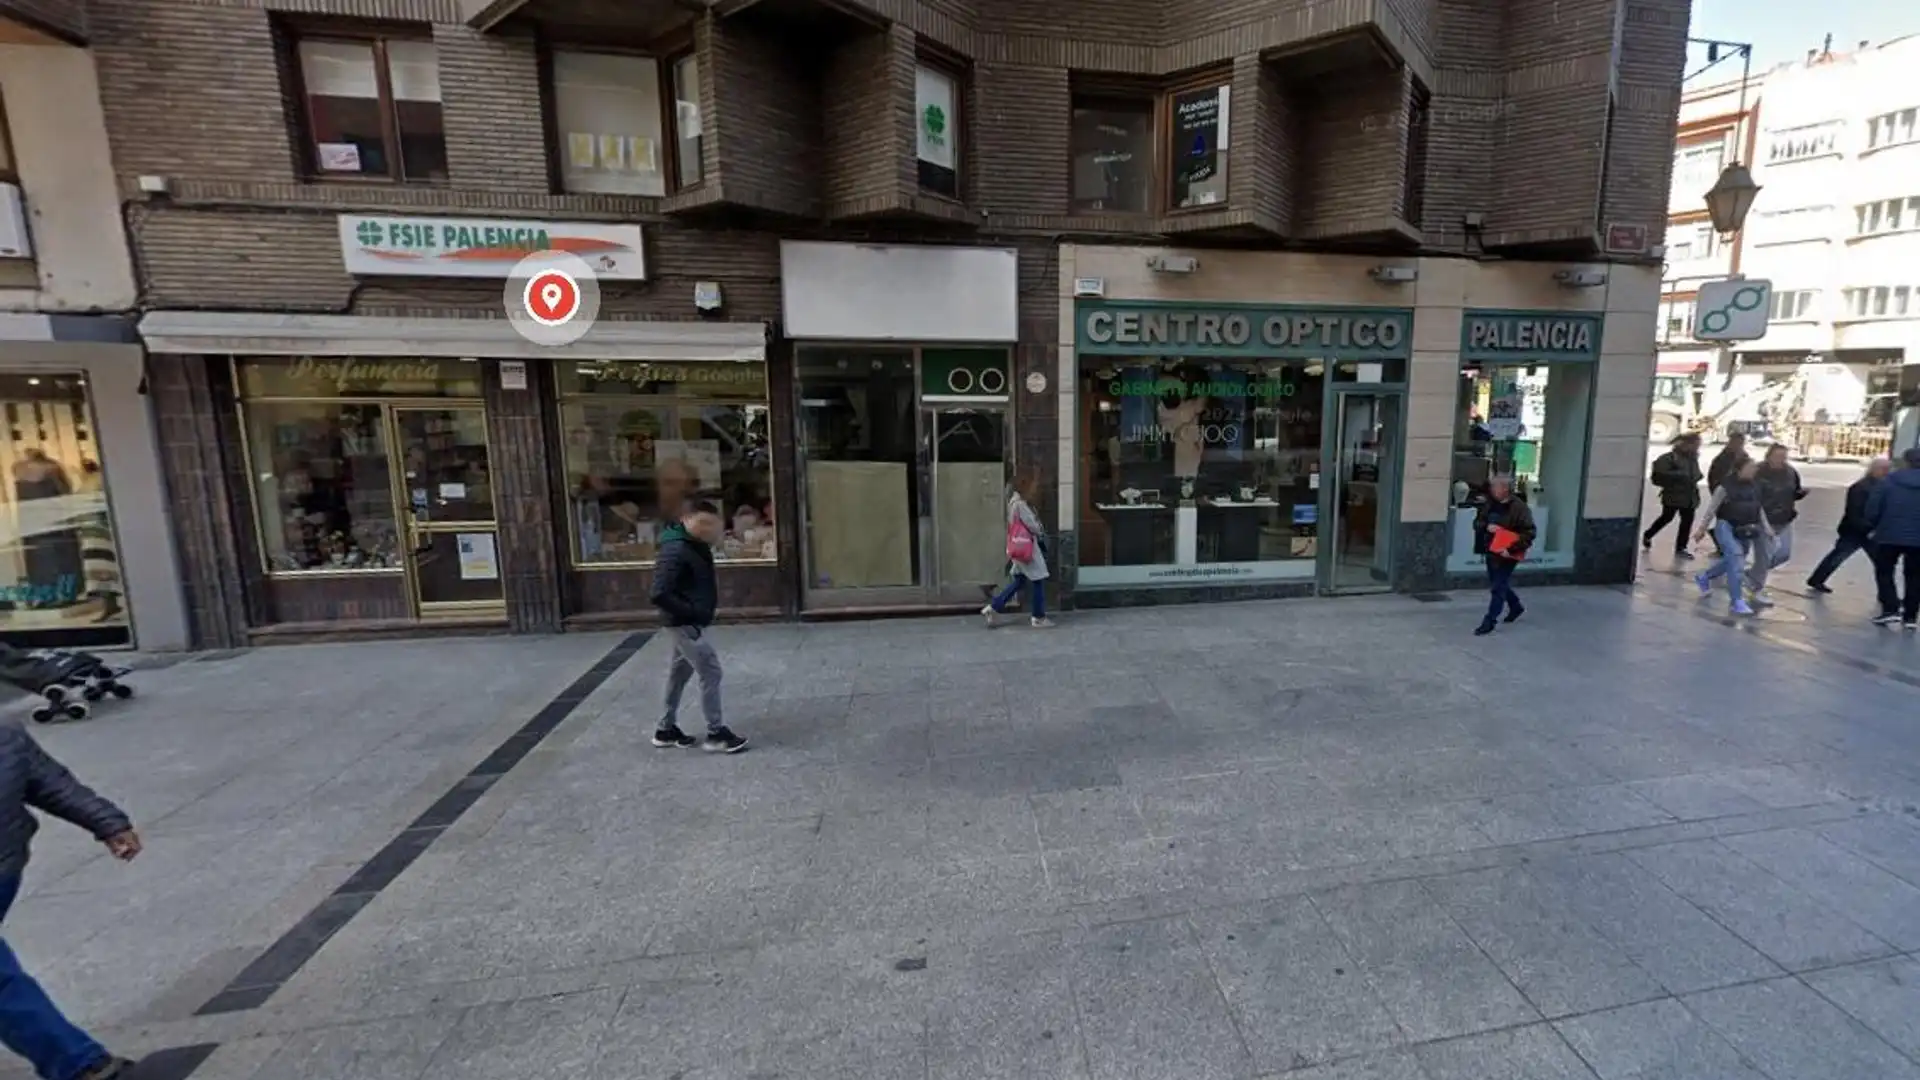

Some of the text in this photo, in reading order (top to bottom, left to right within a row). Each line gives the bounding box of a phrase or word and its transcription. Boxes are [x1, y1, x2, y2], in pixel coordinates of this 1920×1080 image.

[389, 223, 550, 250] FSIE PALENCIA
[1087, 311, 1401, 348] CENTRO OPTICO
[1470, 320, 1591, 349] PALENCIA
[1129, 423, 1175, 443] JIMMY
